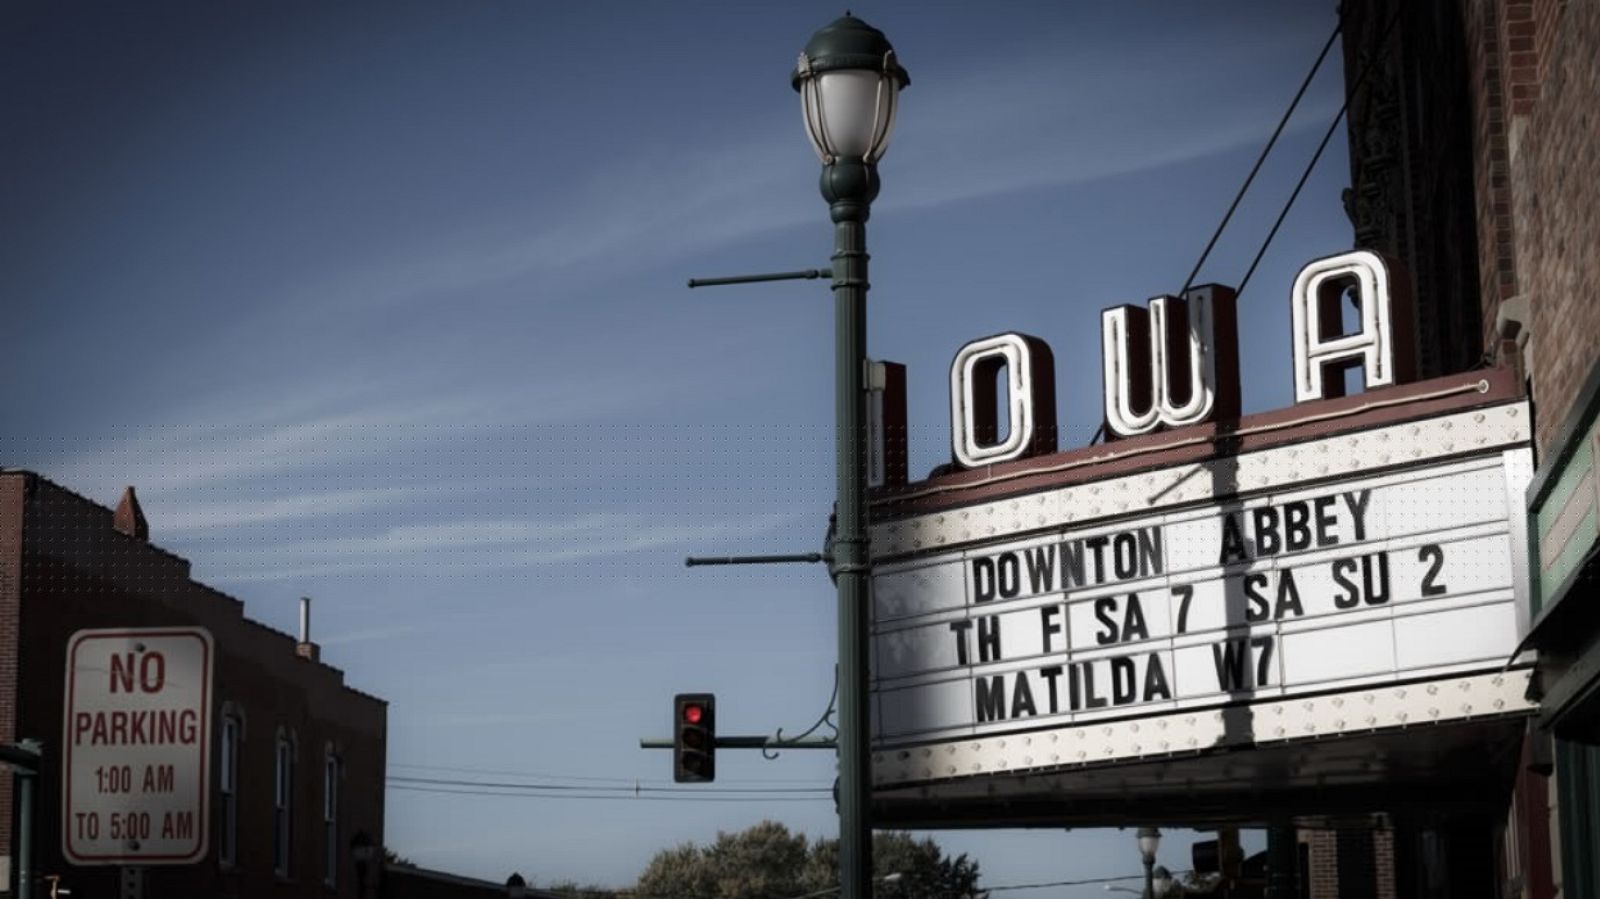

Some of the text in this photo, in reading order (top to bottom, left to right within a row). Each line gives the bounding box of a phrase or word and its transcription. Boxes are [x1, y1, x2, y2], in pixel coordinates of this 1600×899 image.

[973, 490, 1371, 602] DOWNTON ABBEY
[951, 544, 1447, 667] TH F SA 7 SA SU 2
[109, 652, 164, 693] NO
[976, 637, 1274, 723] MATILDA W7
[75, 709, 197, 745] PARKING
[95, 765, 174, 793] 1:00 AM
[75, 811, 193, 839] TO 5:00 AM
